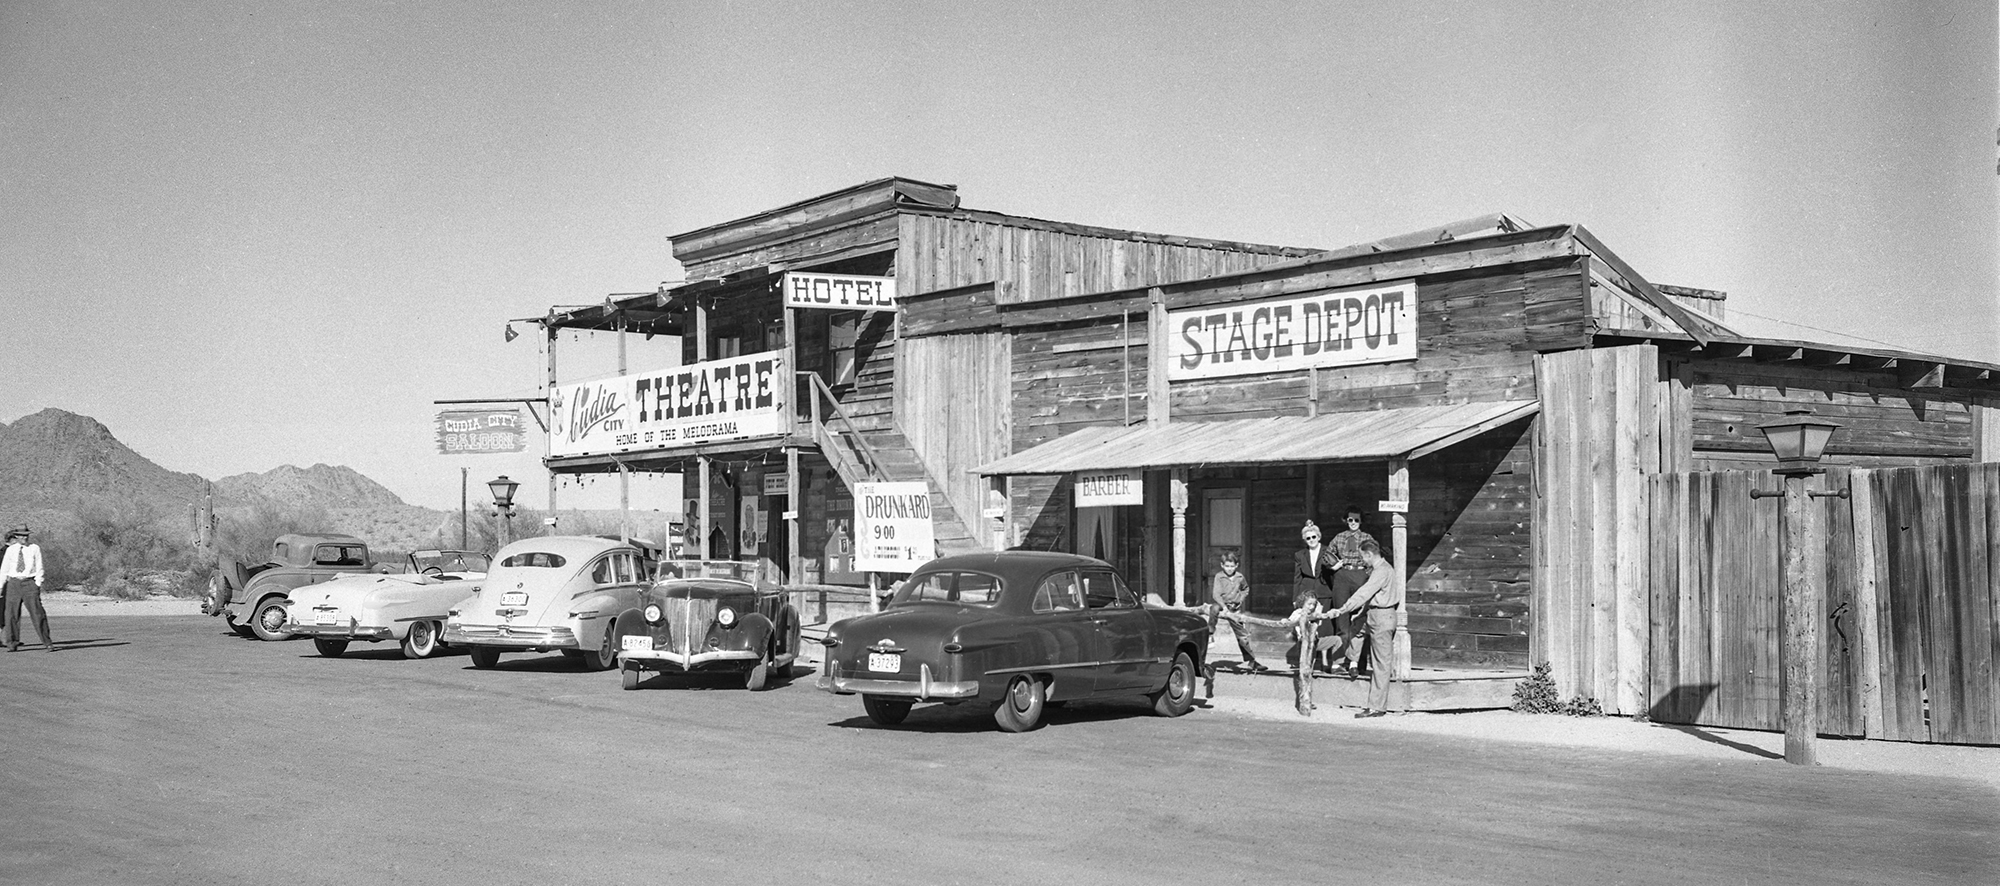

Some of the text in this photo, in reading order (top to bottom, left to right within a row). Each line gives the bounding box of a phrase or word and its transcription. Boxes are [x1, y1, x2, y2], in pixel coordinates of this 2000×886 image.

[791, 277, 892, 306] HOTEL
[1180, 291, 1404, 370] STAGE DEPOT
[636, 360, 773, 423] THEATRE
[445, 414, 517, 433] CUDIA CITY
[567, 384, 626, 443] Cudia
[603, 419, 624, 432] CITY
[445, 432, 515, 451] SALOON
[616, 421, 739, 446] HOME OF THE MELODRAMA
[864, 485, 875, 494] THE
[1082, 473, 1131, 497] BARBER
[865, 494, 931, 519] DRUNKARD
